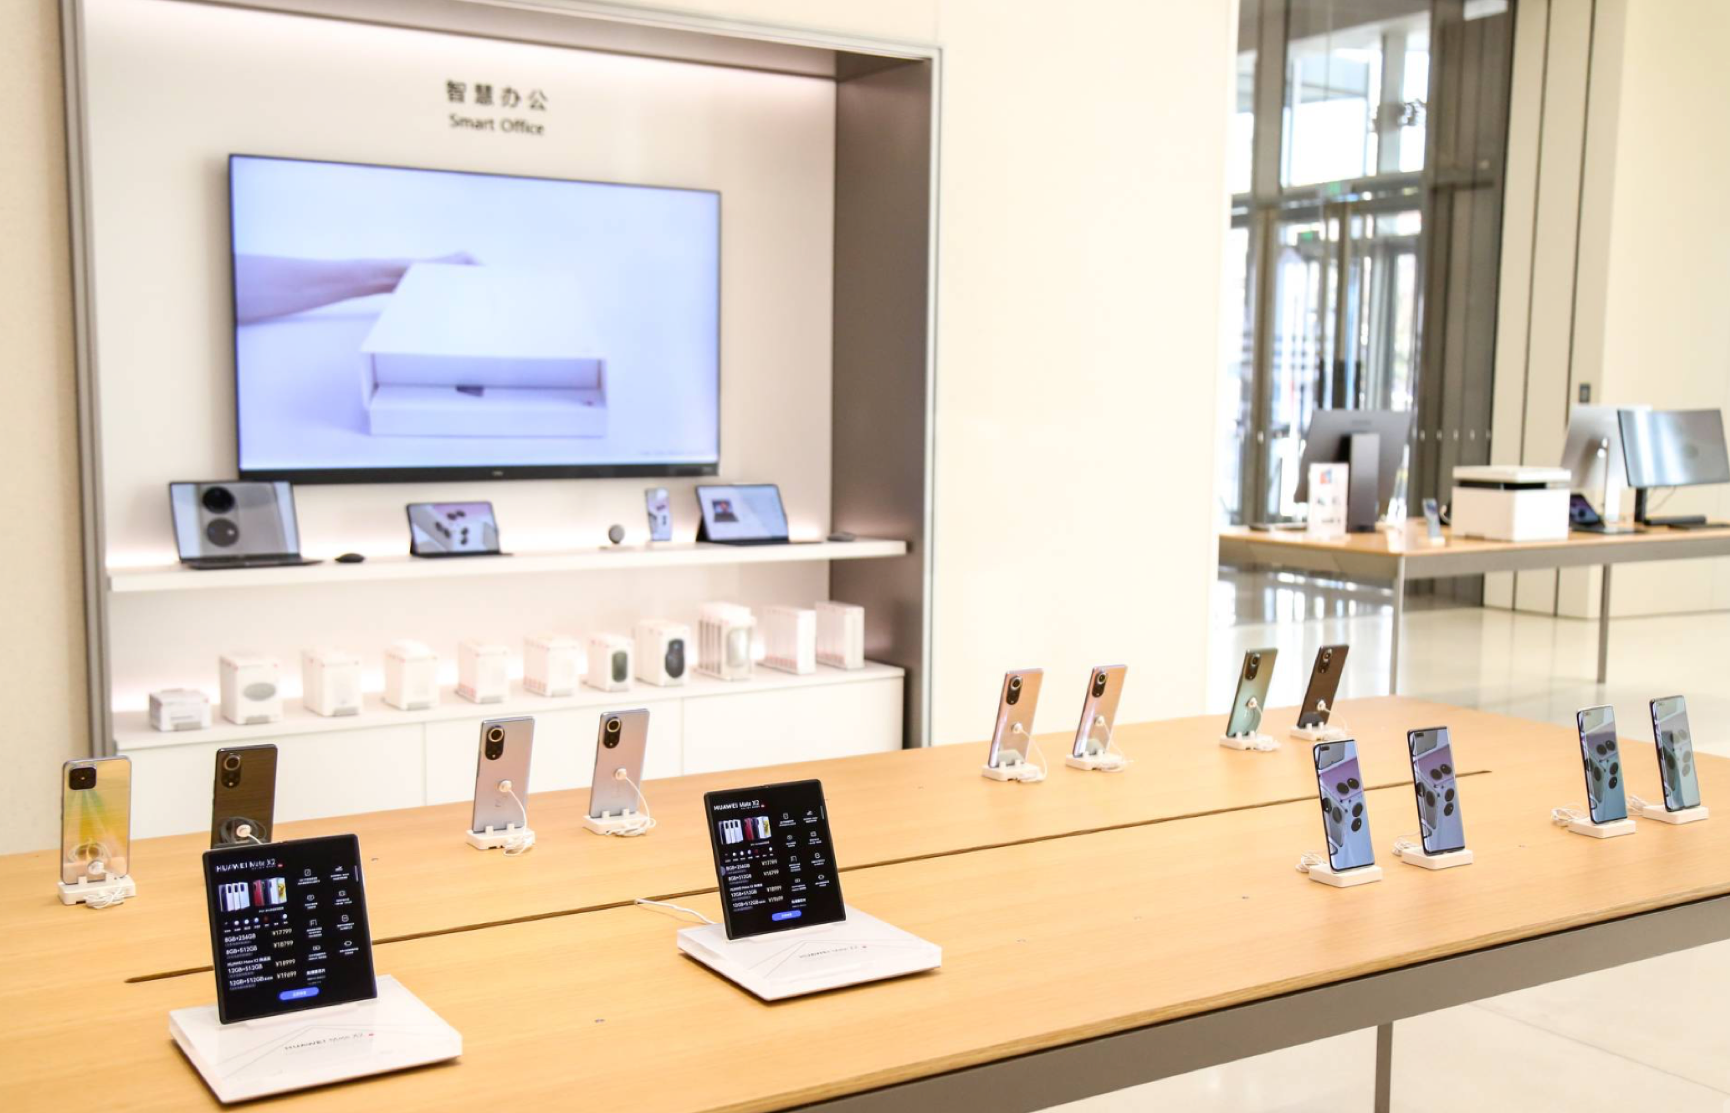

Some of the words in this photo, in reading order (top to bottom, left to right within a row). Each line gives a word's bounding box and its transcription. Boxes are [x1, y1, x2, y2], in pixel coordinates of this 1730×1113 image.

[447, 80, 548, 111] 智慧办公
[449, 113, 495, 131] Smart
[500, 118, 545, 135] Office
[713, 803, 739, 811] HUAWEI
[216, 861, 248, 873] HUAWEI
